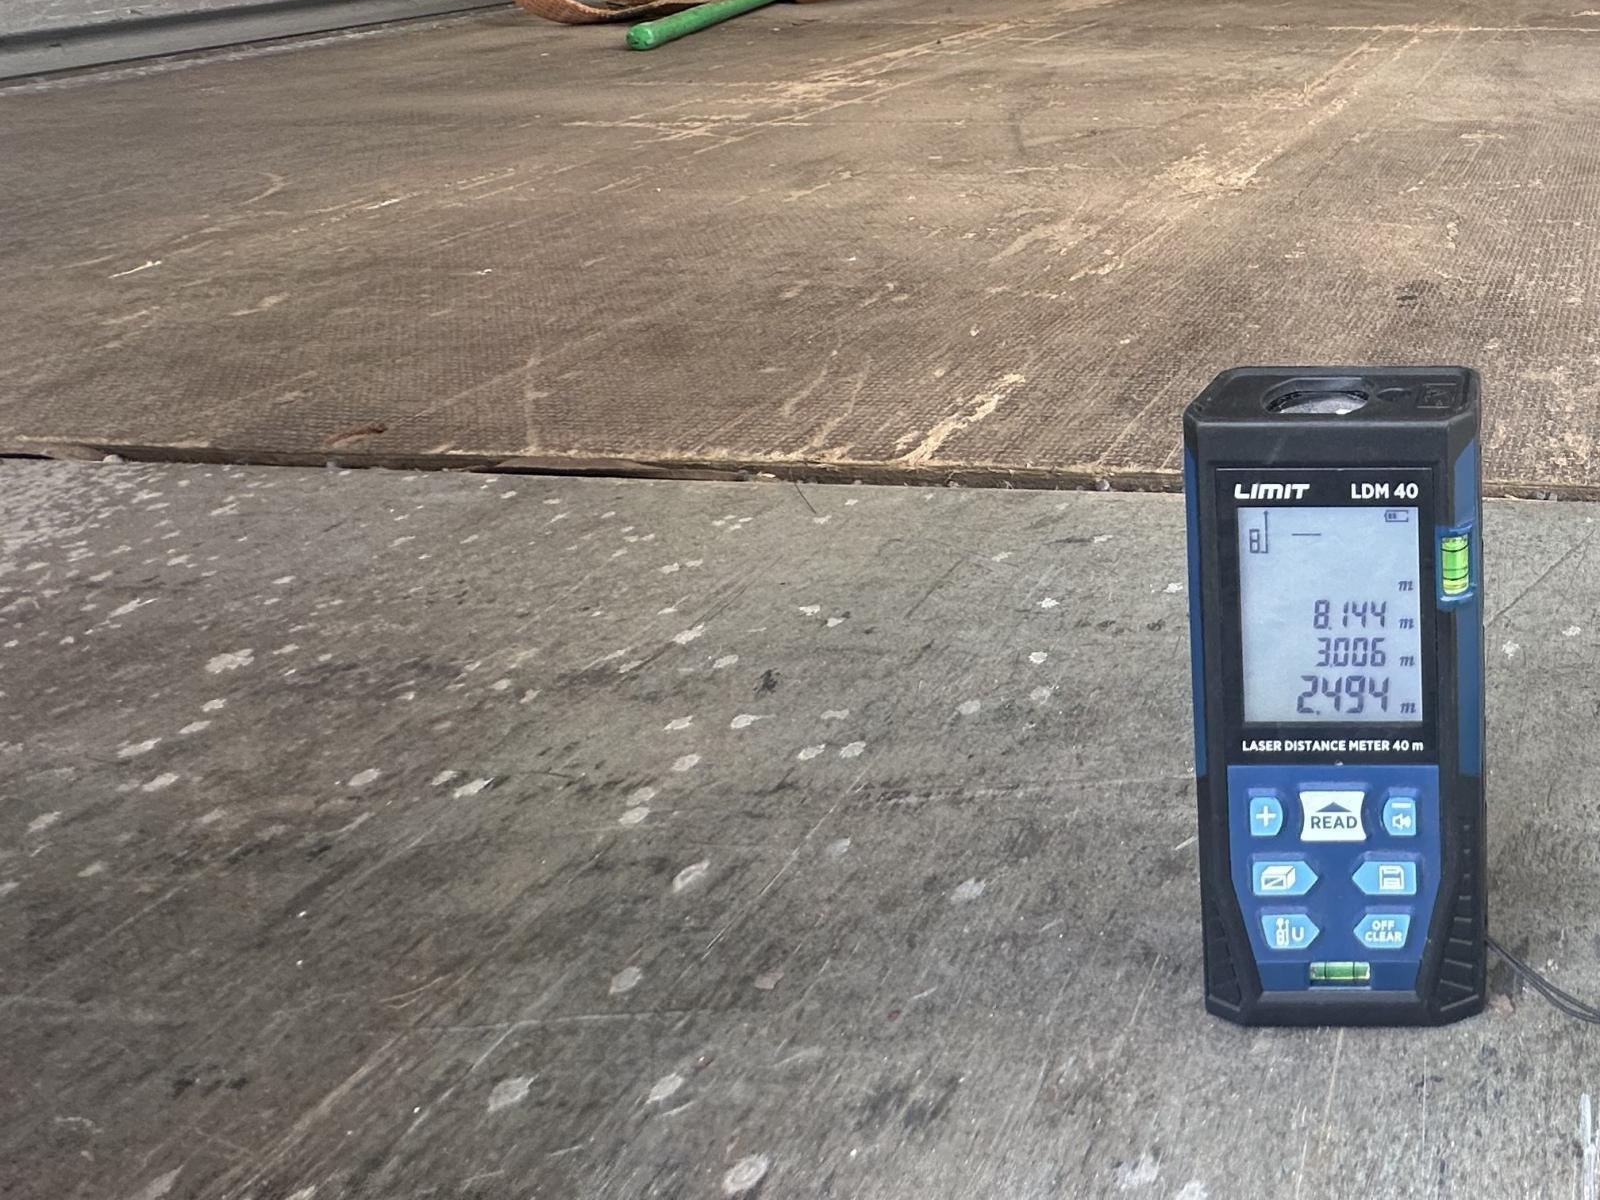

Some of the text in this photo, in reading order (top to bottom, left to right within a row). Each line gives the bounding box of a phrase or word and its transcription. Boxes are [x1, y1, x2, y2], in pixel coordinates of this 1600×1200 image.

[1234, 483, 1310, 500] LIMIT
[1351, 483, 1419, 499] LDM 40
[1313, 599, 1414, 631] 8.144 m
[1316, 637, 1415, 667] 3.006 m
[1297, 675, 1416, 715] 2.494 m
[1242, 740, 1424, 752] LASER DISTANCE METER 40 m
[1310, 816, 1358, 830] READ
[1372, 920, 1395, 930] OFF
[1365, 931, 1402, 942] CLEAR
